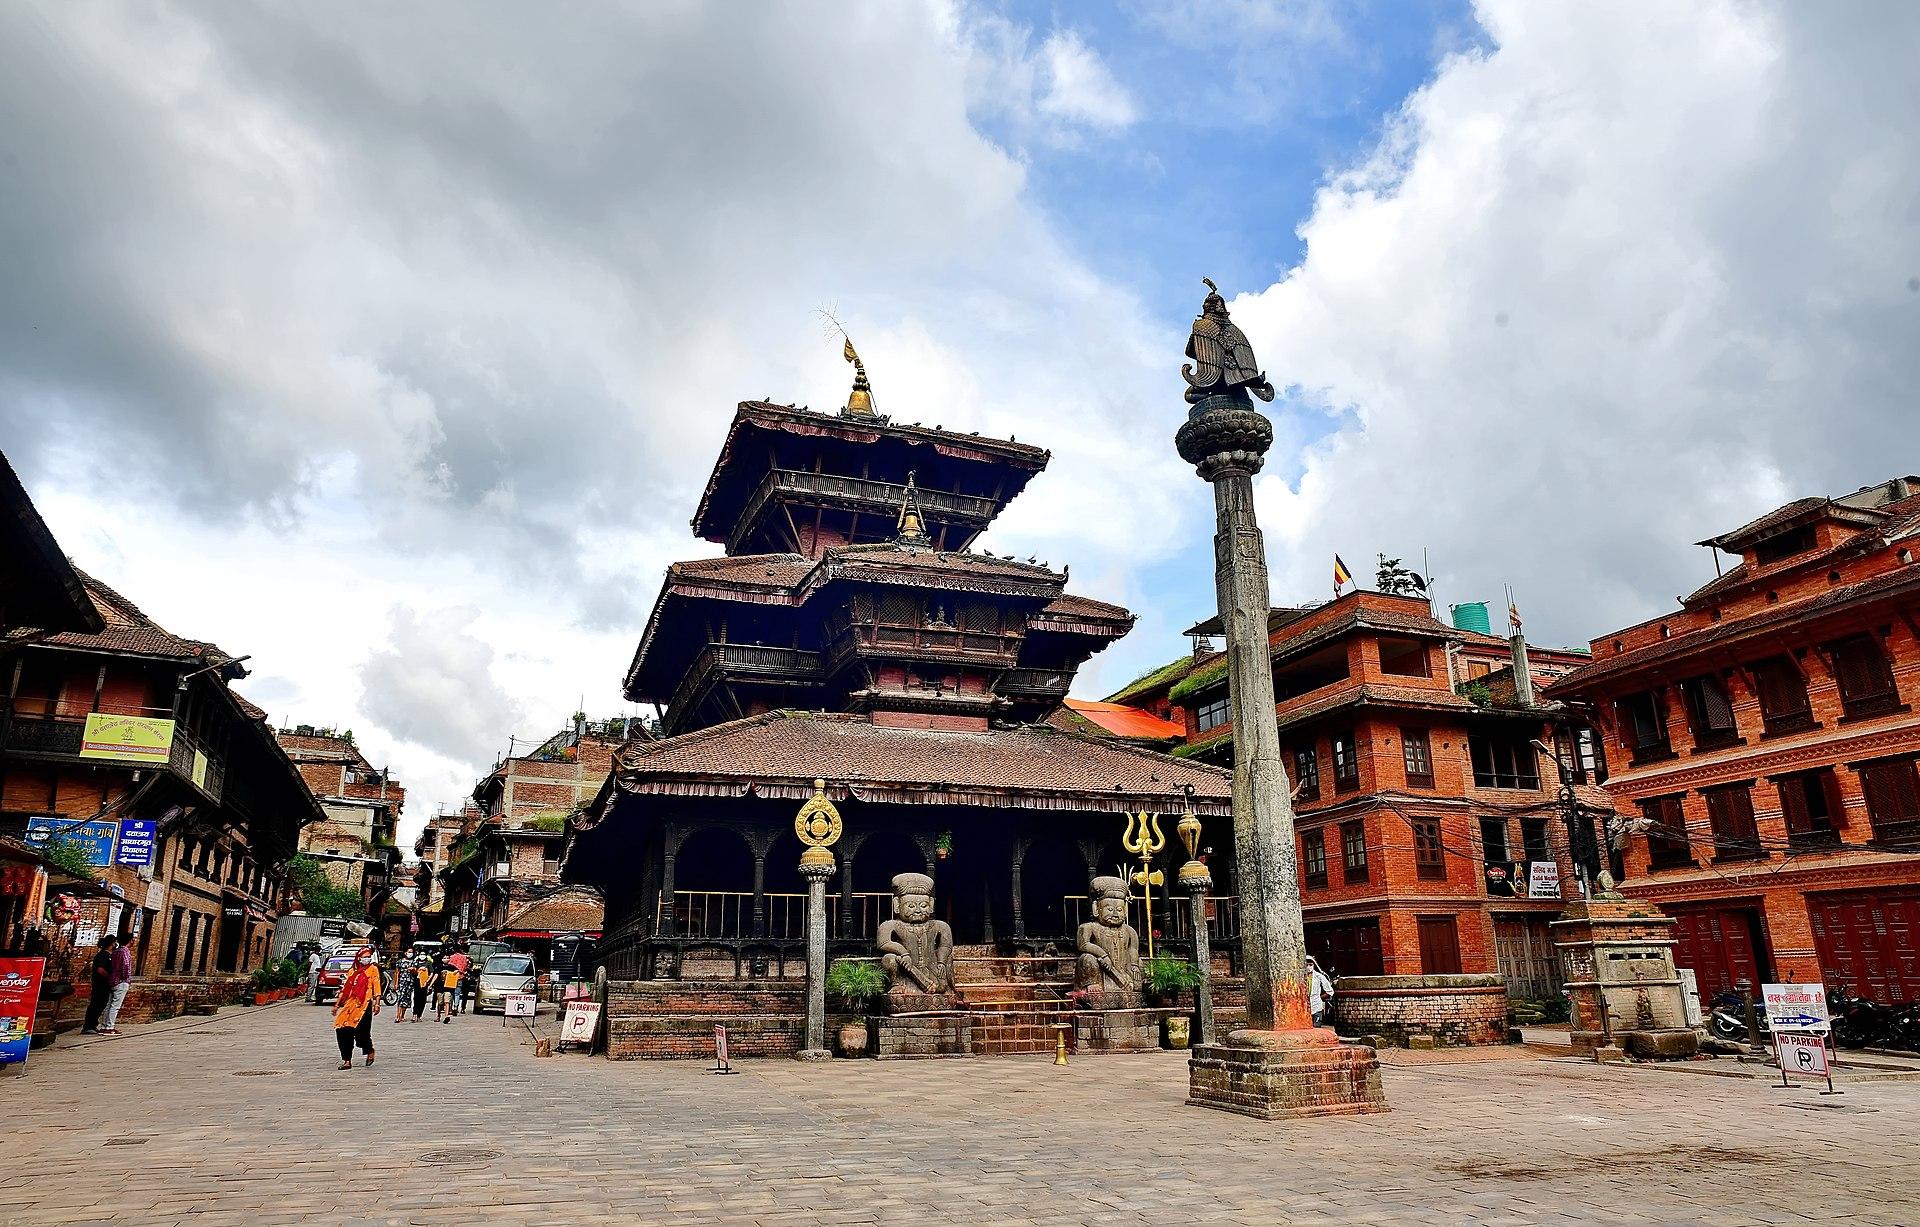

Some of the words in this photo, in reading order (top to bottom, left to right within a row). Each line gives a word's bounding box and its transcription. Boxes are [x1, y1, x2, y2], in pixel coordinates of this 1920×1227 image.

[576, 1003, 600, 1012] PARKING
[1780, 1035, 1790, 1045] NO
[1791, 1036, 1822, 1047] PARKING
